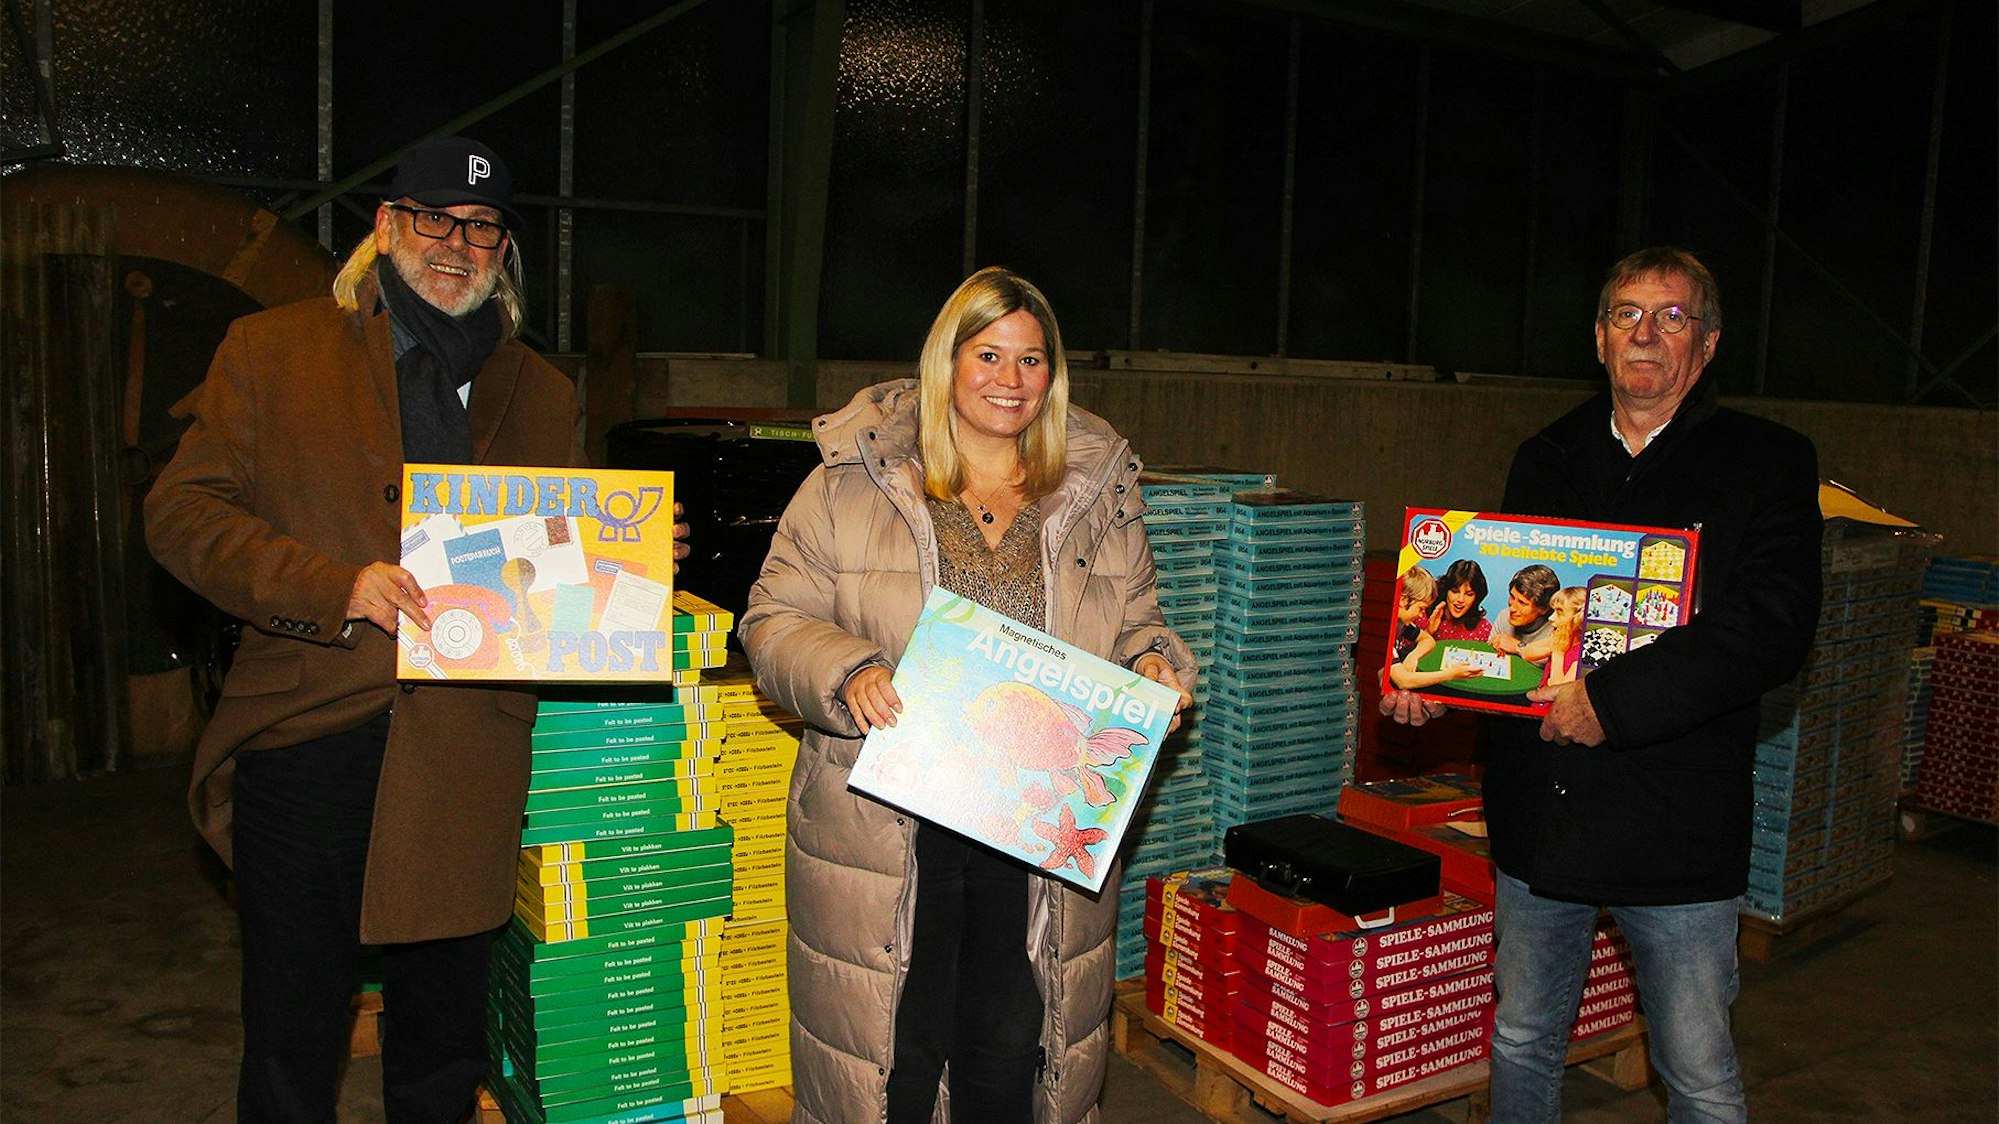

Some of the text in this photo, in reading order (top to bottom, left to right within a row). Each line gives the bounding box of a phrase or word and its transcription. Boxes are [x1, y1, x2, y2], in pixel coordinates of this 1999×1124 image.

[468, 155, 490, 185] P
[409, 473, 602, 517] KINDER
[1257, 510, 1292, 518] ANGELSPIEL
[1464, 524, 1637, 560] Spiele-Sammlung
[1500, 544, 1567, 564] beliebte
[1568, 547, 1618, 567] Spiele
[1256, 583, 1293, 591] ANGELSPIEL
[1251, 600, 1288, 609] ANGELSPIEL
[546, 630, 666, 673] POST
[999, 623, 1068, 661] Magnetisches
[966, 627, 1160, 730] Angelspiel
[1269, 927, 1308, 952] SAMMLUNG
[1380, 911, 1494, 948] SPIELE-SAMMLUNG
[1267, 946, 1304, 970] SAMMLUNG
[1376, 933, 1493, 970] SPIELE-SAMMLUNG
[1265, 966, 1304, 992] SAMMLUNG
[1376, 950, 1488, 990] SPIELE-SAMMLUNG
[1272, 986, 1310, 1011] SAMMLUNG
[1381, 973, 1494, 1010] SPIELE-SAMMLUNG
[1578, 993, 1634, 1018] SAMMLUNG
[1270, 1008, 1309, 1034] SAMMLUNG
[1380, 992, 1492, 1032] SPIELE-SAMMLUNG
[1266, 1028, 1307, 1054] SAMMLUNG
[1376, 1027, 1483, 1070] SPIELE-SAMMLUNG
[1266, 1048, 1306, 1074] SAMMLUNG
[1376, 1045, 1482, 1090] SPIELE-SAMMLUNG
[1267, 1067, 1308, 1094] SAMMLUNG
